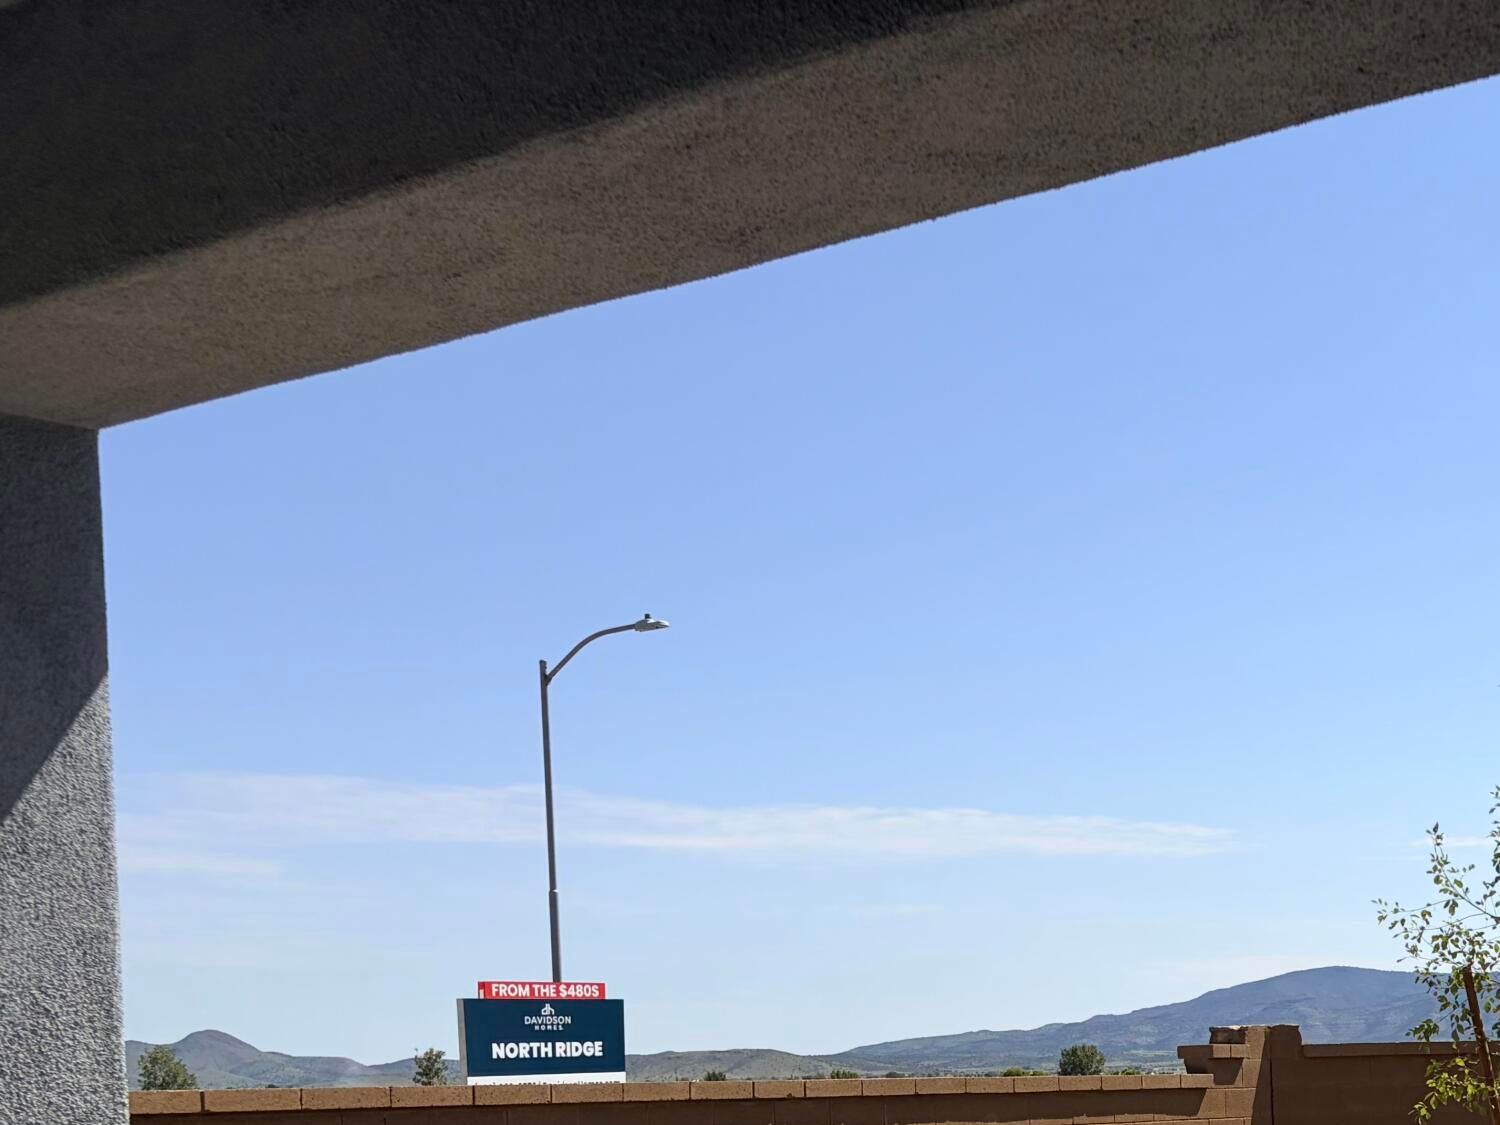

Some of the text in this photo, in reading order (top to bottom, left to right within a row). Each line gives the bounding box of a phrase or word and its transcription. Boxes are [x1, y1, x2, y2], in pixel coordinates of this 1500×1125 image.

[492, 983, 600, 998] FROM THE $480S
[524, 1015, 572, 1025] DAVIDSON
[491, 1041, 603, 1060] NORTH RIDGE
